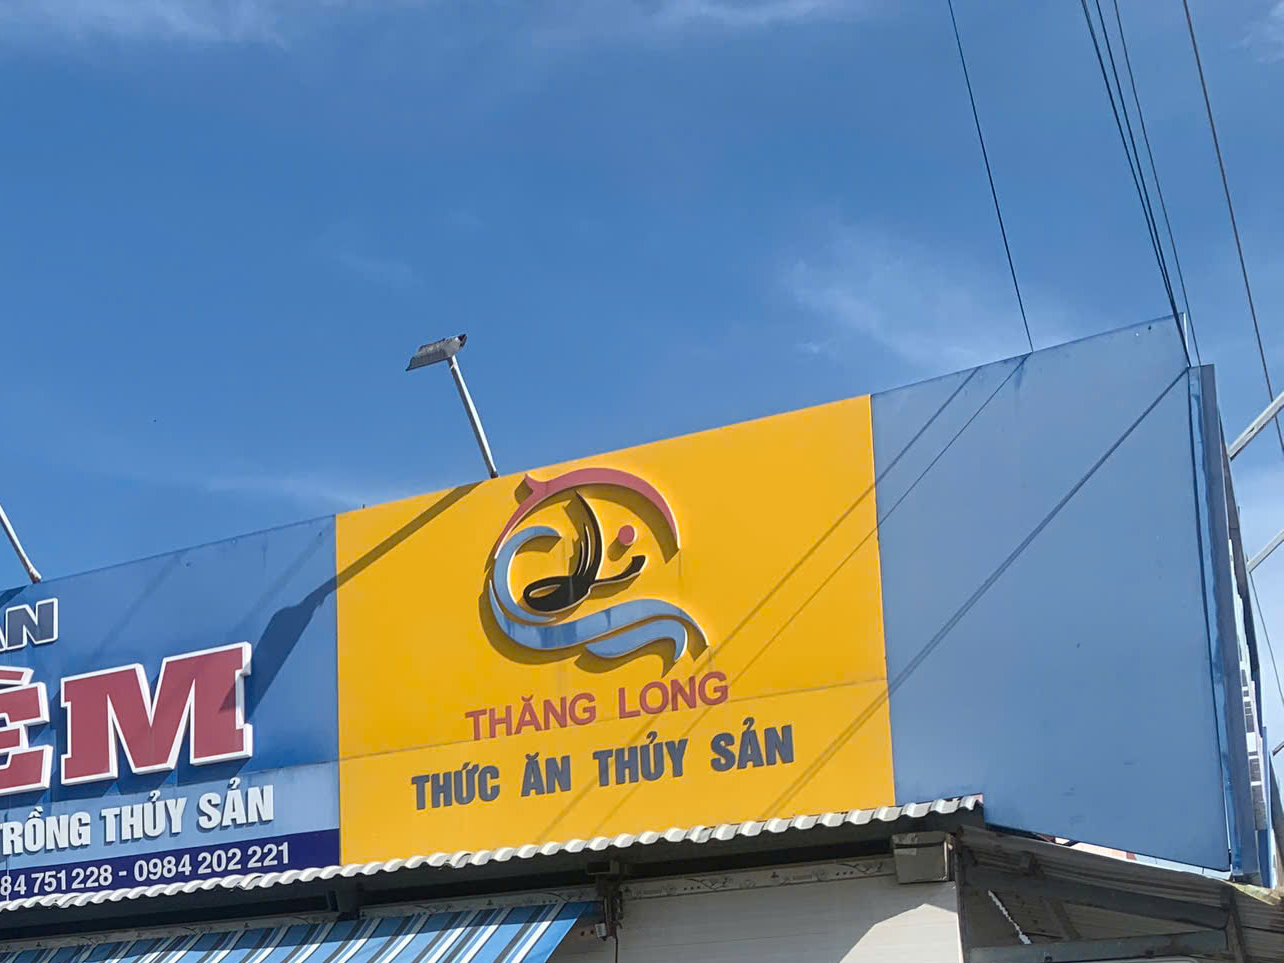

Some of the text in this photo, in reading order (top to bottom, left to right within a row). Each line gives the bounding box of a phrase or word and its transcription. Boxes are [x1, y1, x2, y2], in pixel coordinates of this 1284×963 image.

[465, 670, 729, 741] THĂNG LONG
[412, 716, 795, 810] THỨC ĂN THỦY SẢN
[101, 790, 187, 844] THỦY
[199, 777, 274, 830] SẢN
[133, 853, 192, 883] 0984
[198, 847, 243, 873] 202
[247, 842, 290, 867] 221
